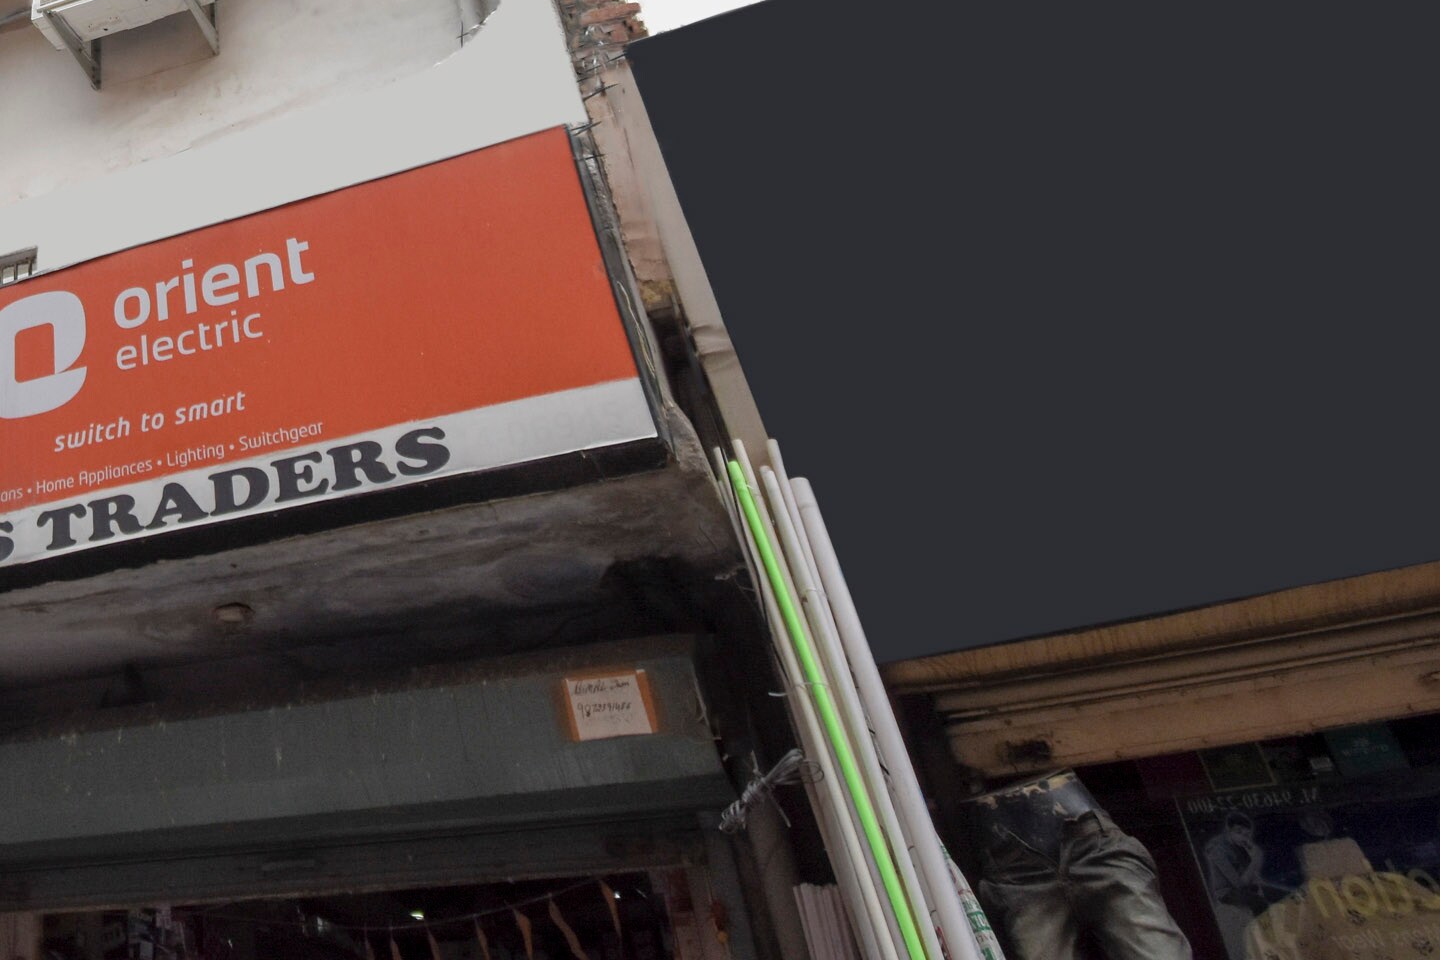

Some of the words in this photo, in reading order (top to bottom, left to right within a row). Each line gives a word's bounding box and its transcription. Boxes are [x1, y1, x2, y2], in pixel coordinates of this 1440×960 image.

[113, 237, 315, 329] orient
[116, 310, 264, 370] electric
[36, 474, 74, 494] Home
[79, 459, 153, 487] Appliances
[167, 443, 225, 468] Lighting
[238, 422, 324, 451] Switchgear
[53, 417, 131, 453] switch
[141, 411, 165, 434] to
[175, 391, 246, 426] smart
[37, 427, 452, 551] TRADERS
